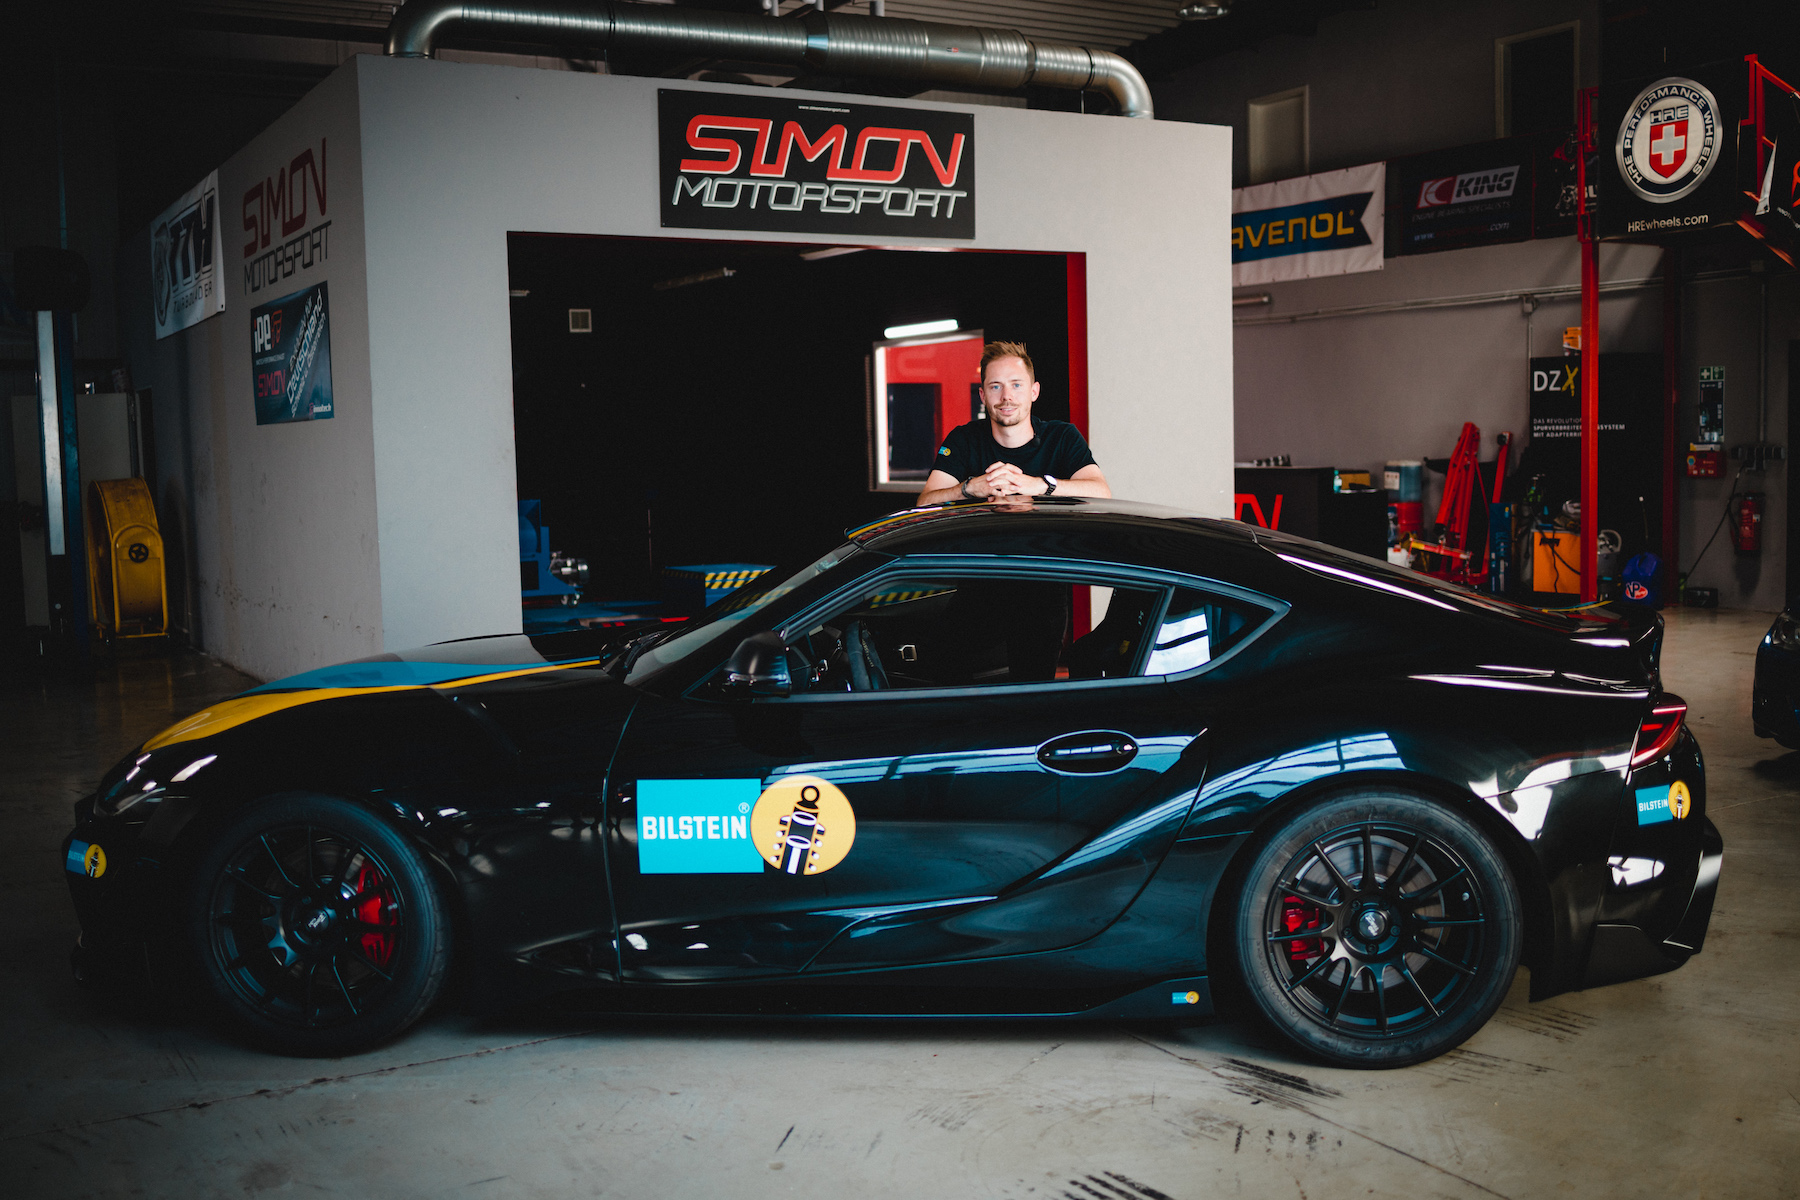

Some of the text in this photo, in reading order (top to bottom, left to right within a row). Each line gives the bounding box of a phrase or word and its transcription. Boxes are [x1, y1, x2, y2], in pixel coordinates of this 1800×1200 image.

[1650, 104, 1689, 124] HRE
[680, 114, 966, 187] SIMON
[1623, 86, 1714, 184] HRE PERFORMANCE WHEELS
[243, 137, 326, 259] SIMON
[672, 175, 967, 219] MOTORSPORT
[1455, 171, 1515, 198] KING
[1232, 211, 1355, 249] AVENOL
[1627, 214, 1709, 232] HREwheels.com
[244, 219, 332, 296] MOTORSPORT
[287, 288, 323, 405] Deutschland
[258, 369, 286, 398] SIMON
[1533, 364, 1579, 397] DZX
[1638, 799, 1669, 812] BILSTEIN
[642, 815, 747, 840] BILSTEIN
